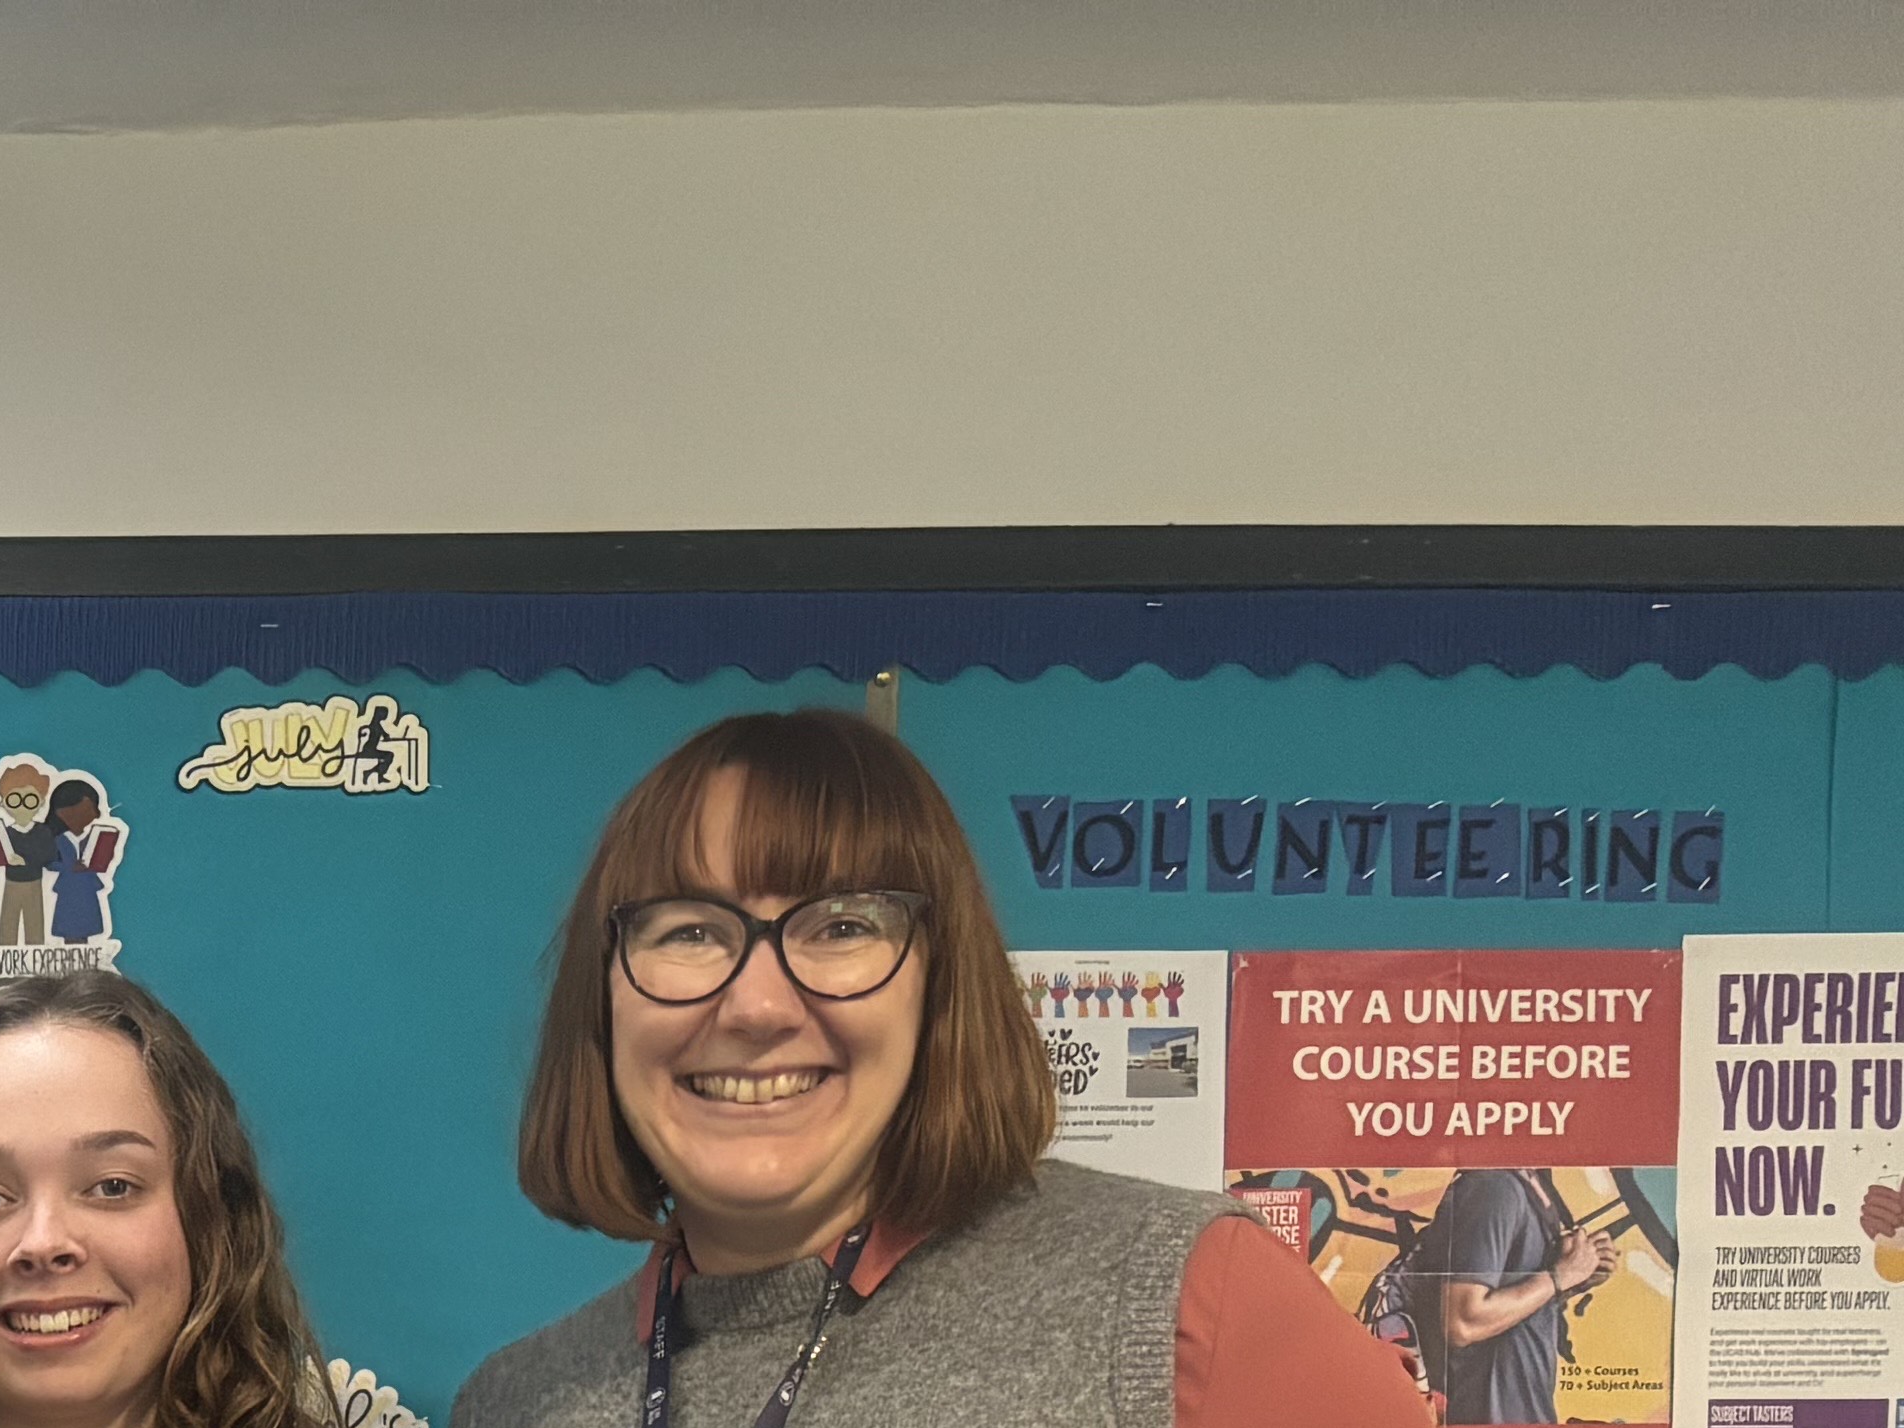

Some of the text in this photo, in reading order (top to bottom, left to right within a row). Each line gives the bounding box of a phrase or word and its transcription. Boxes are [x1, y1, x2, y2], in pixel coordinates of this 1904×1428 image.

[1018, 808, 1722, 894] VOLUNTEERING
[33, 946, 103, 976] EXPERIENCE
[1272, 987, 1653, 1025] TRY A UNIVERSITY
[1291, 1044, 1632, 1081] COURSE BEFORE
[1715, 1059, 1837, 1131] YOUR
[1345, 1101, 1575, 1137] YOU APPLY
[1713, 1144, 1838, 1219] NOW.
[1715, 1246, 1861, 1265] TRY UNIVERSITY COURSES
[1712, 1269, 1822, 1287] AND VIRTUAL WORK
[1712, 1291, 1781, 1311] EXPERIENCE
[1784, 1291, 1827, 1310] BEFORE
[1830, 1291, 1853, 1310] YOU
[1560, 1366, 1581, 1377] 150
[1594, 1365, 1639, 1377] Courses
[1560, 1380, 1574, 1390] 70
[1587, 1380, 1630, 1392] Subject
[1632, 1380, 1663, 1391] Areas
[1711, 1405, 1793, 1425] SUBJECT TASTERS
